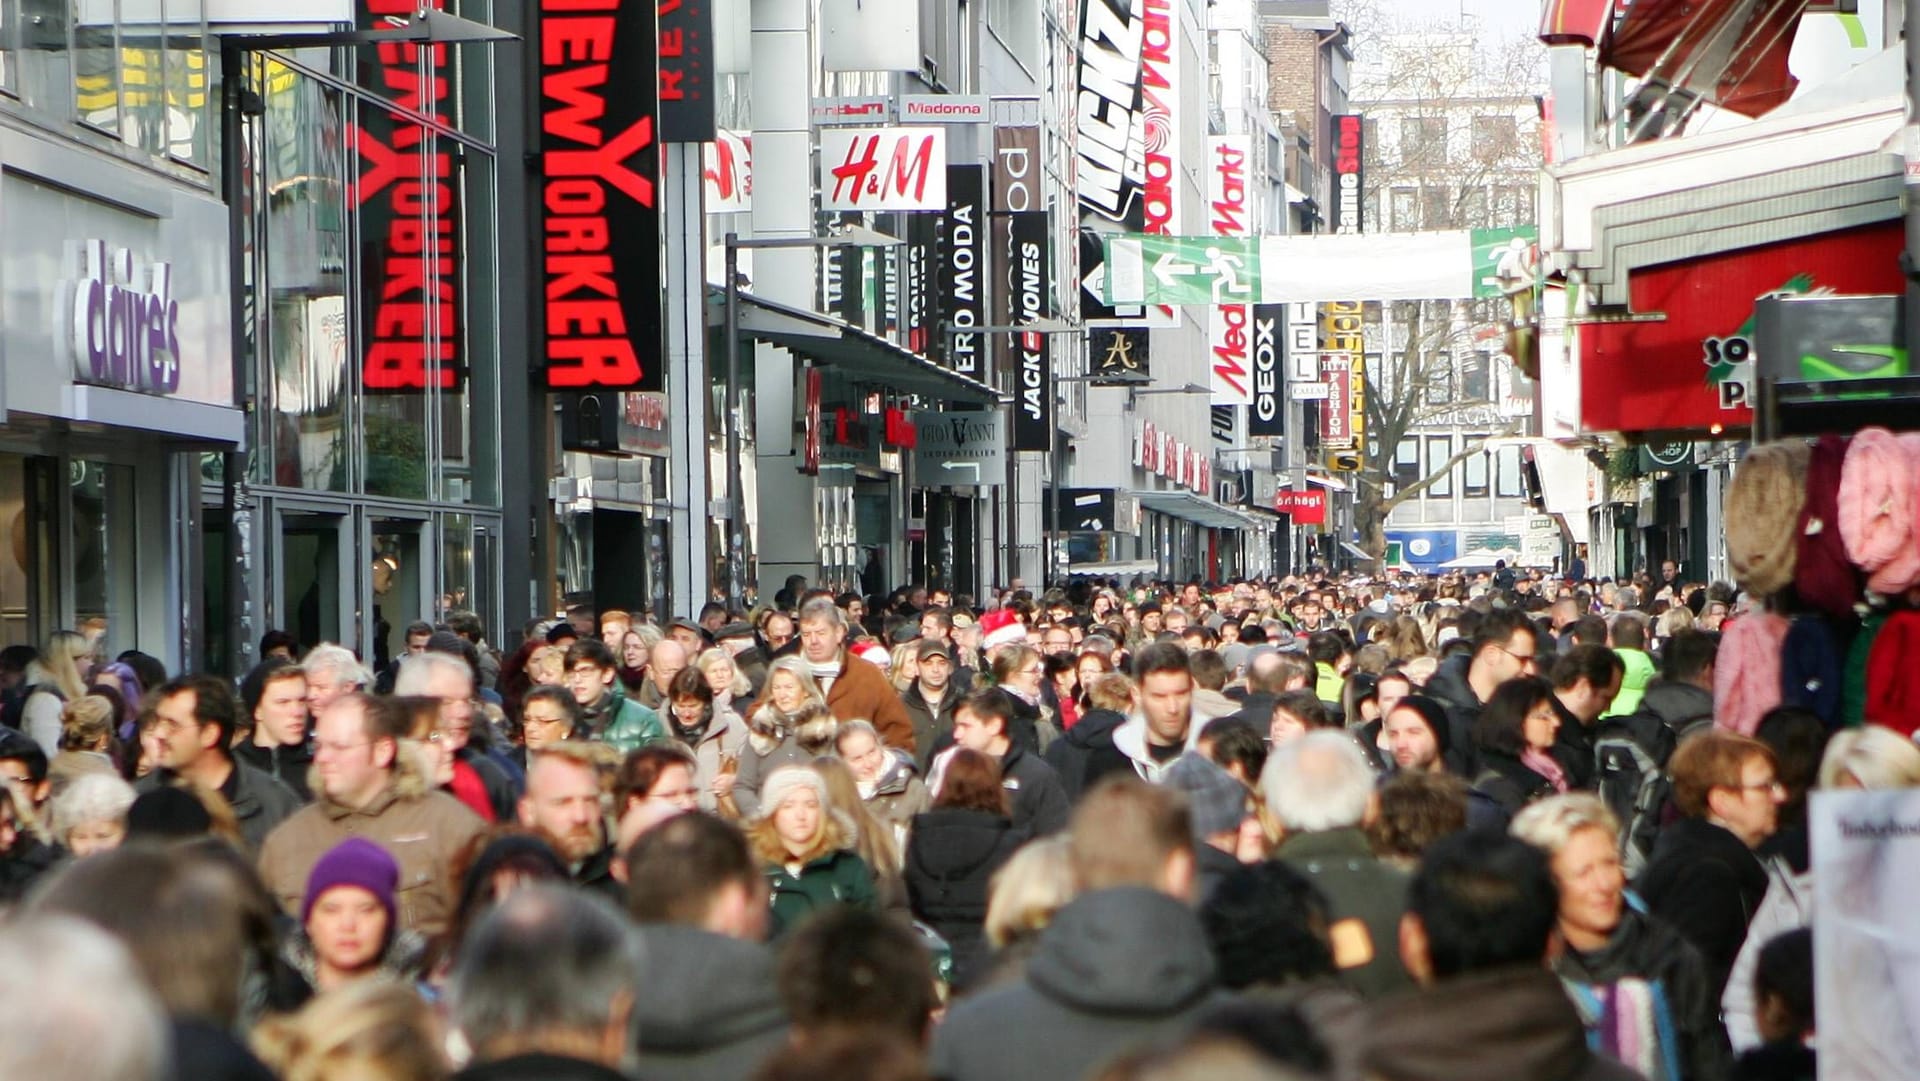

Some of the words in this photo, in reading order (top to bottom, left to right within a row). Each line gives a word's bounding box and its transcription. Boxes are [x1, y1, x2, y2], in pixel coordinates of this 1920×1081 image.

[907, 103, 981, 114] Madonna
[831, 135, 934, 205] H&M
[953, 204, 974, 300] MODA
[1022, 349, 1041, 421] JACK
[1256, 318, 1275, 421] GEOX
[1329, 373, 1342, 435] FASHION
